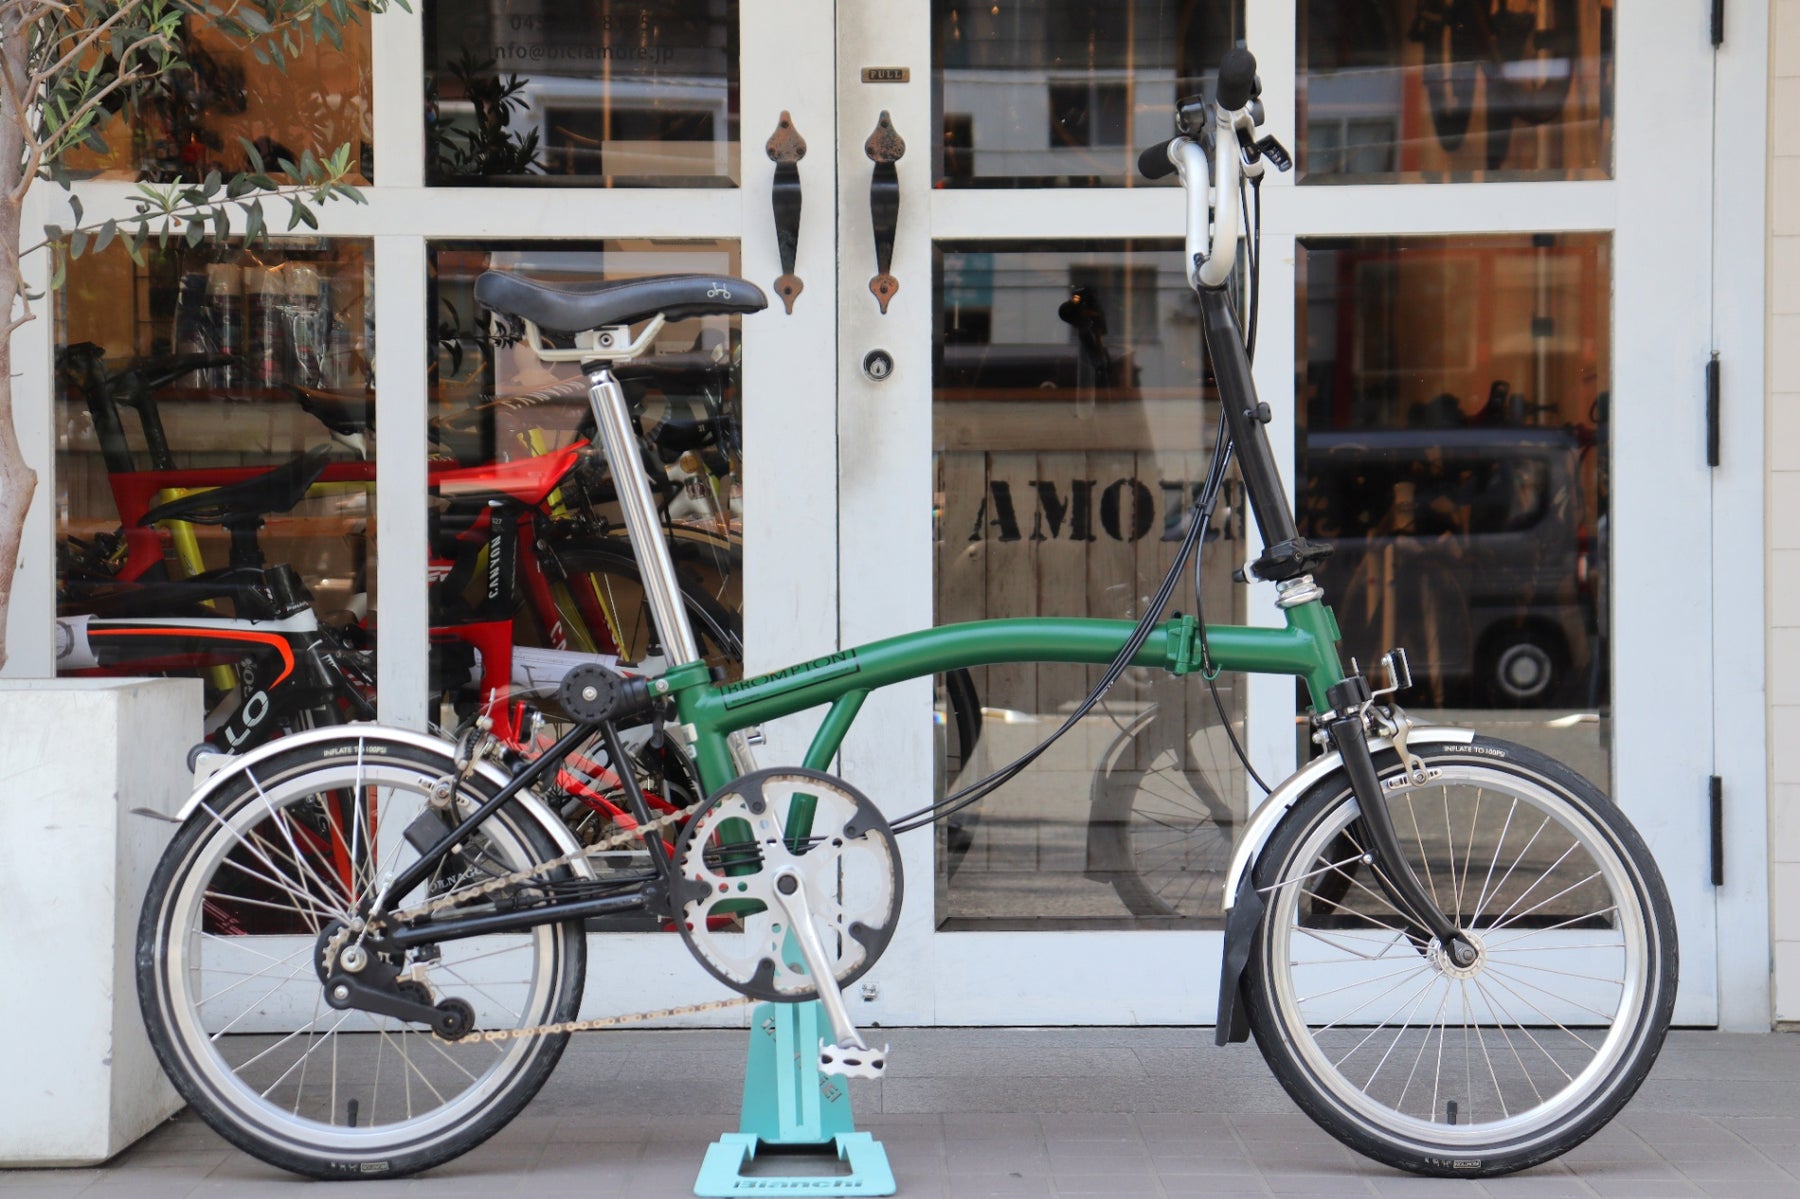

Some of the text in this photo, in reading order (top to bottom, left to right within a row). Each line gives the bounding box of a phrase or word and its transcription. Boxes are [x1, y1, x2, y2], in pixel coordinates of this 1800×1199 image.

[870, 70, 901, 79] PULL
[489, 535, 502, 599] CANYON
[728, 650, 847, 694] BROMPTON
[323, 745, 352, 757] INFLATE
[733, 1179, 863, 1189] Bianchi
